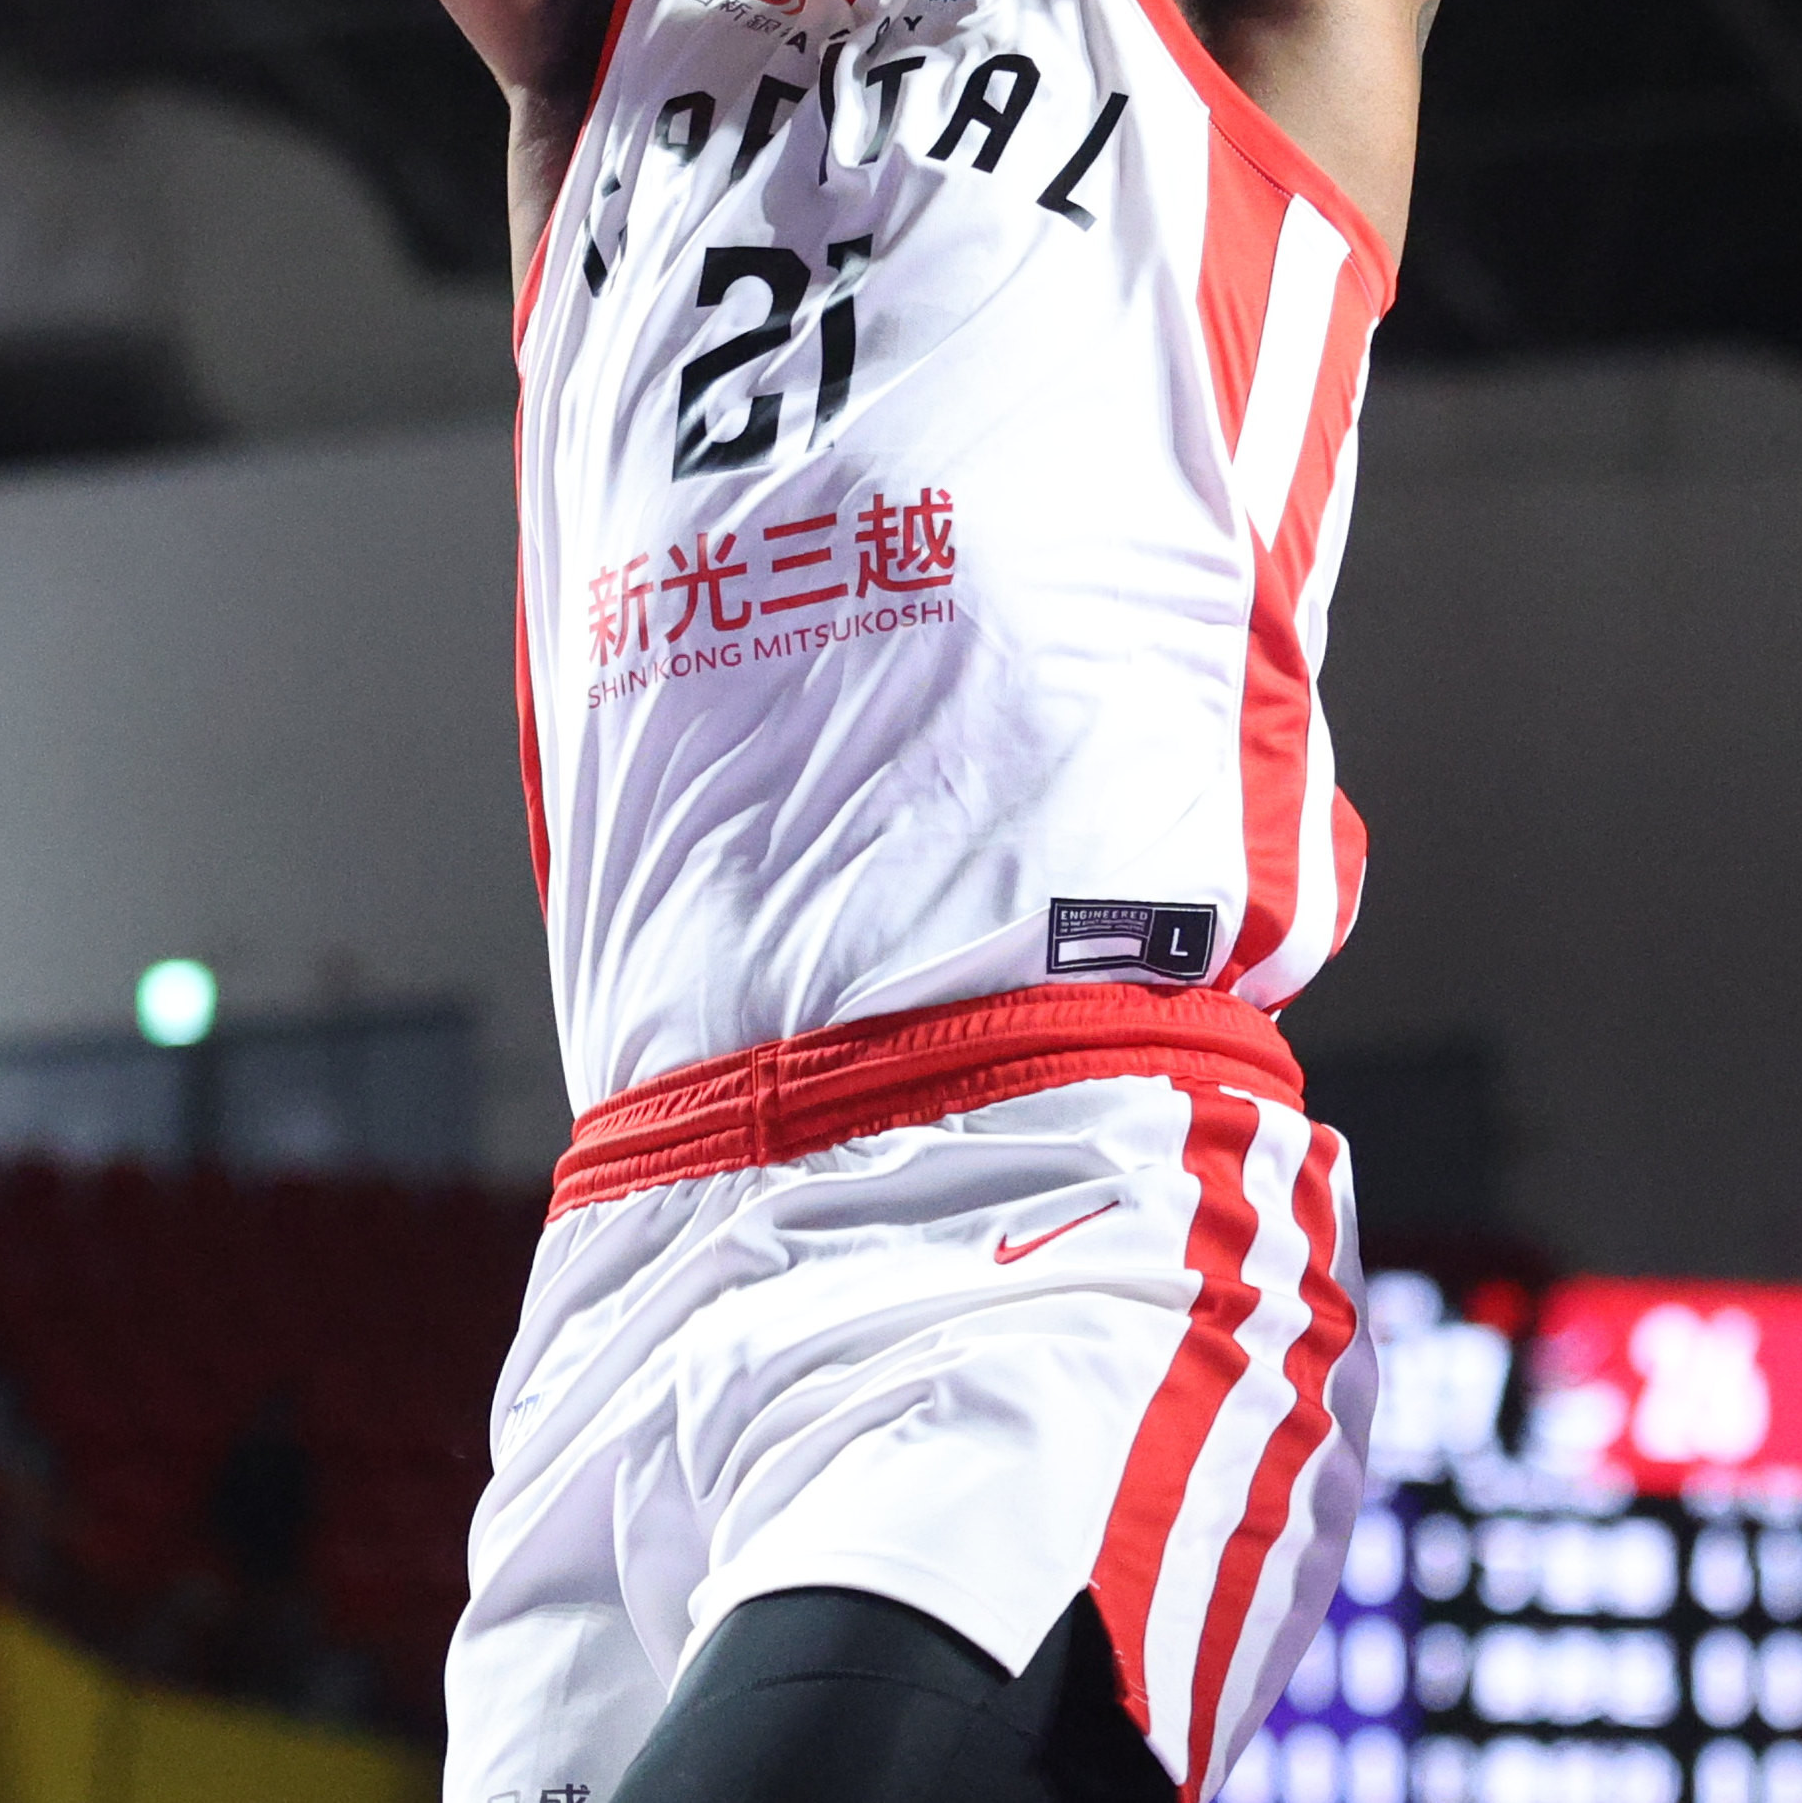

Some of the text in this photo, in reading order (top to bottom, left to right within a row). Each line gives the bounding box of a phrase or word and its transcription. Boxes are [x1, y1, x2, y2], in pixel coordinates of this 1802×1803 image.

[671, 232, 874, 482] 21
[587, 487, 955, 667] 新光三越
[587, 598, 955, 710] SHIN KONG MITSUKOSHI
[1059, 909, 1149, 921] ENGINEERED
[1169, 927, 1189, 957] L
